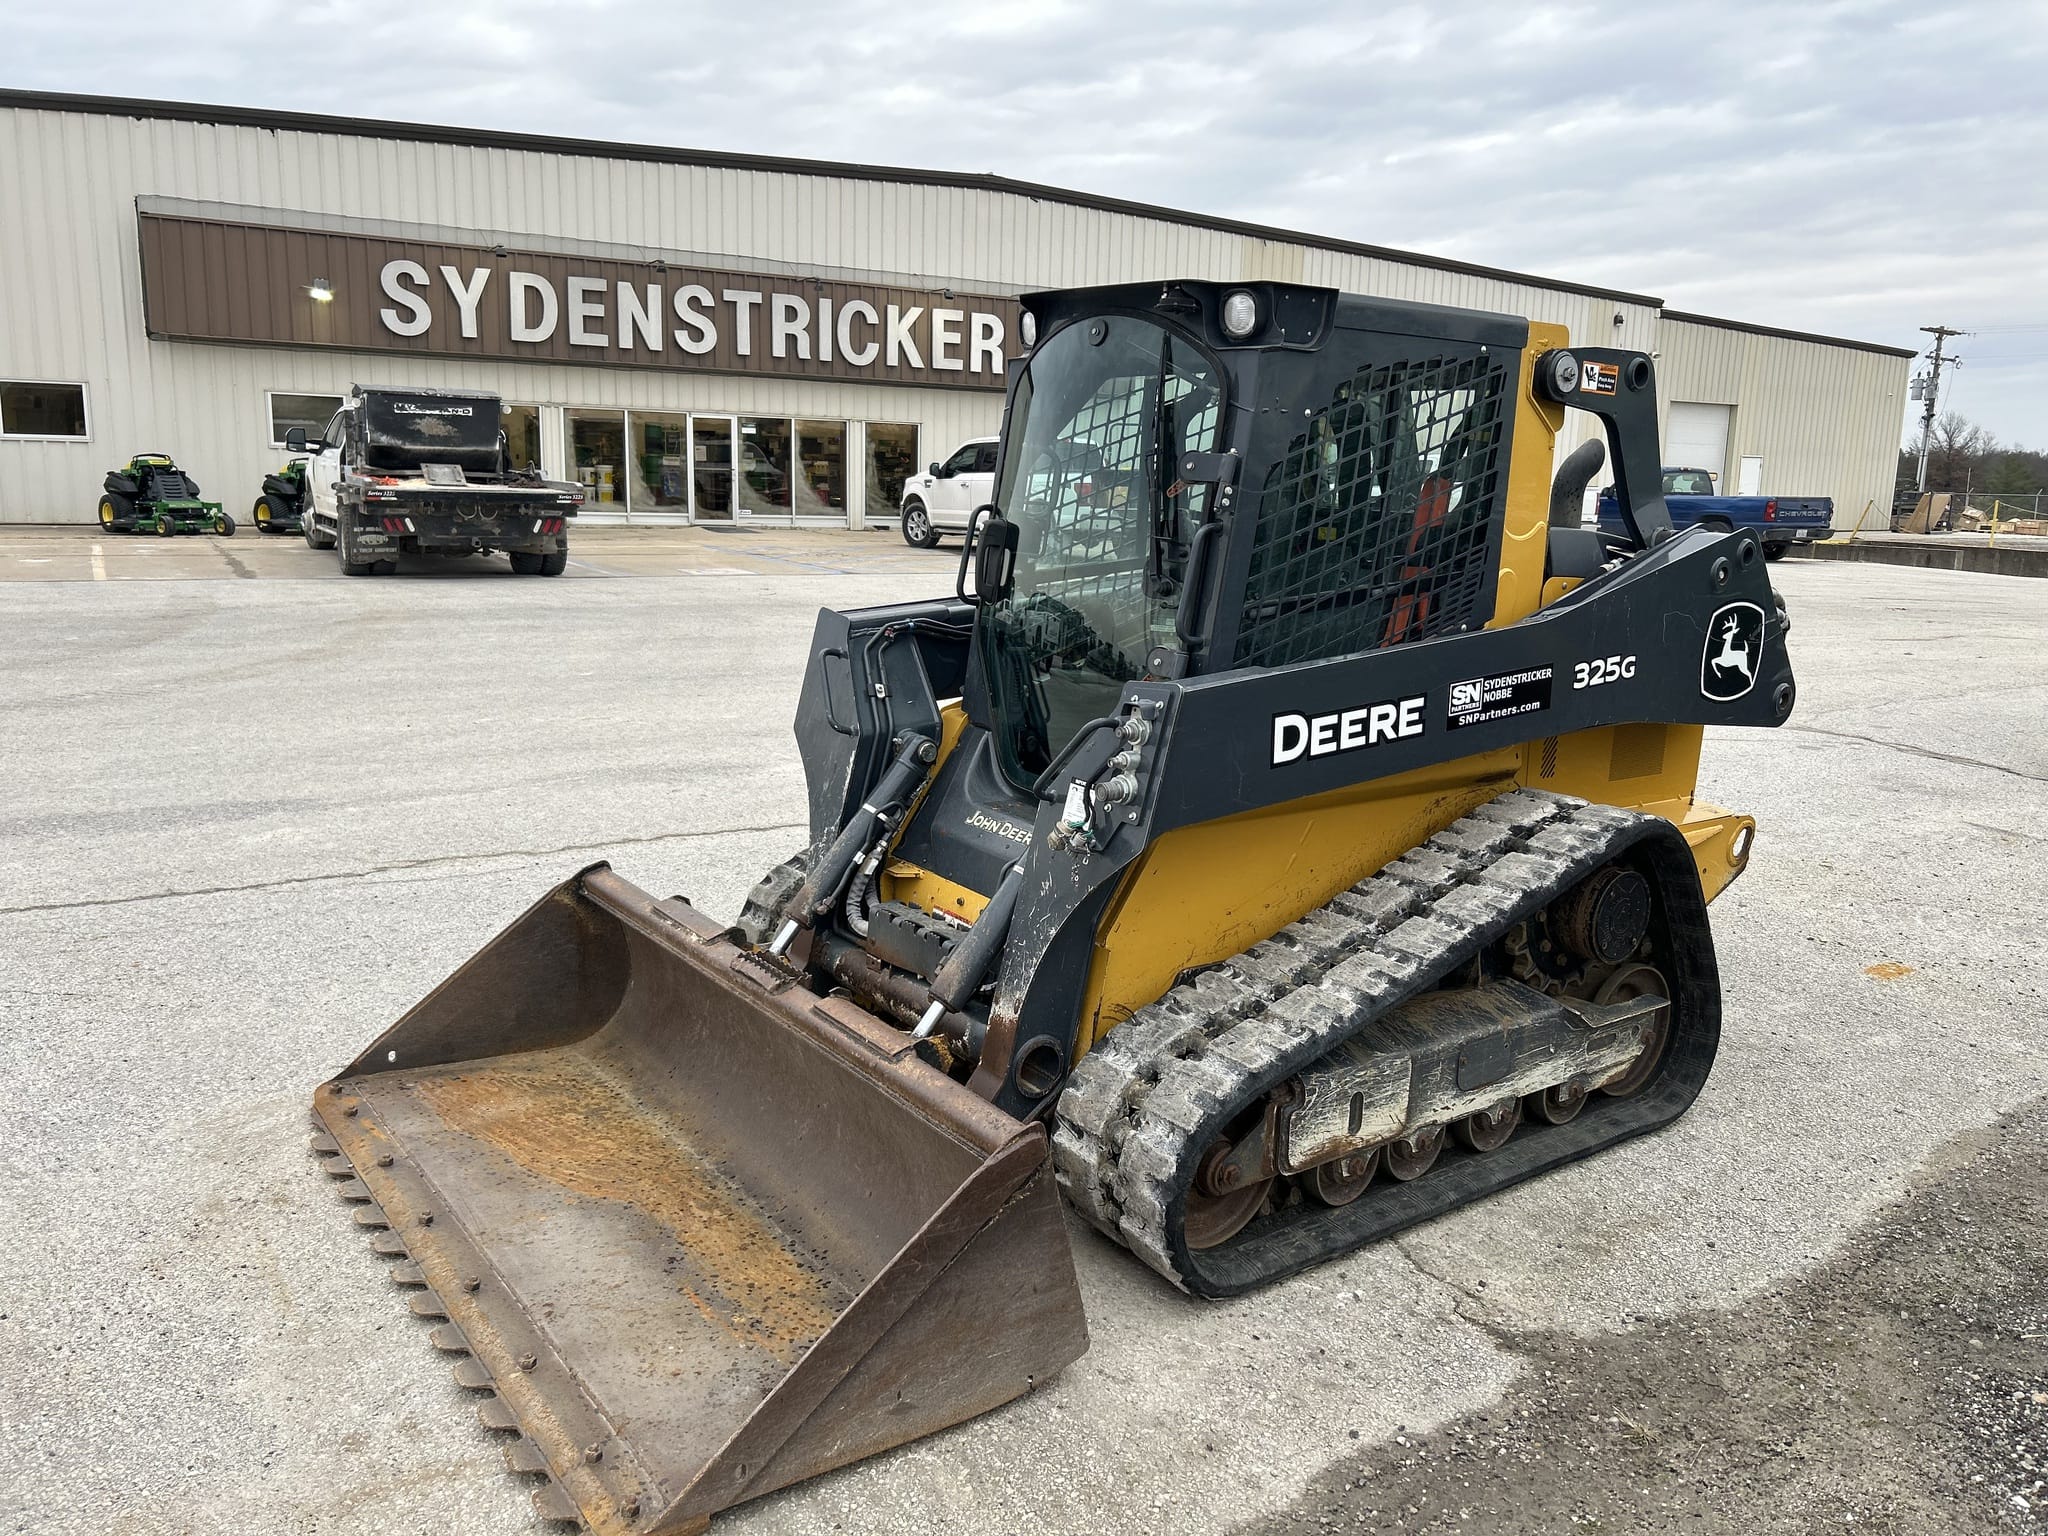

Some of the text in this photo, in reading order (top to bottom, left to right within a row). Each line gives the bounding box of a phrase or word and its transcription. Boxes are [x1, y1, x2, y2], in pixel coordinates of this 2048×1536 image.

[379, 259, 1005, 375] SYDENSTRICKER
[1779, 510, 1827, 518] CHEVROLET
[1483, 668, 1552, 691] SYDENSTRICKER
[1573, 655, 1636, 689] 325G
[1452, 682, 1481, 706] SN
[1483, 687, 1513, 703] NOBBE
[1451, 702, 1480, 713] PARTNERS
[1458, 701, 1541, 726] SNPartners.com
[1273, 697, 1425, 764] DEERE
[965, 810, 1033, 845] JOHN DEER
